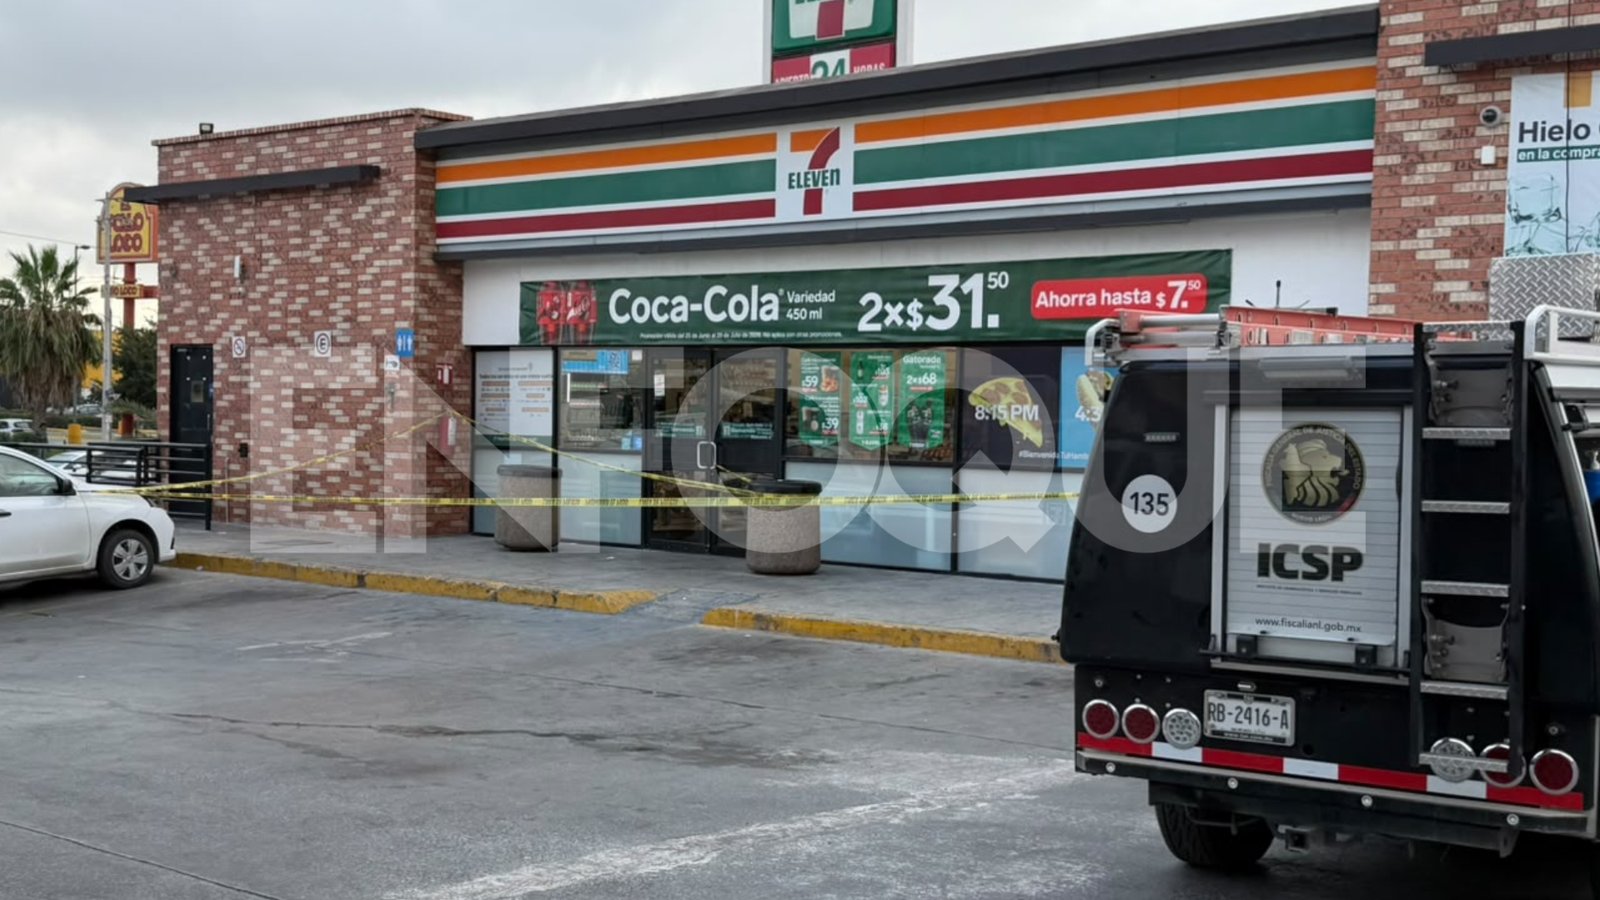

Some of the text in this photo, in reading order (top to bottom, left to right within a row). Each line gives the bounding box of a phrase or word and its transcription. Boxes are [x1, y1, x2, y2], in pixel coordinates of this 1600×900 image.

[1518, 119, 1591, 143] Hielo
[1518, 150, 1535, 161] en
[1538, 148, 1550, 160] la
[788, 168, 840, 189] ELEVEN
[608, 284, 779, 324] Coca-Cola
[786, 289, 836, 303] Variedad
[1035, 291, 1097, 308] Ahorra
[1101, 288, 1151, 306] hasta
[786, 307, 822, 320] 450 ml
[975, 405, 1039, 421] 8:15 PM
[1130, 492, 1169, 516] 135
[1257, 543, 1364, 582] ICSP
[1255, 617, 1362, 633] www.fiscalianl.gob.mx
[1208, 702, 1289, 730] RB-2416-A
